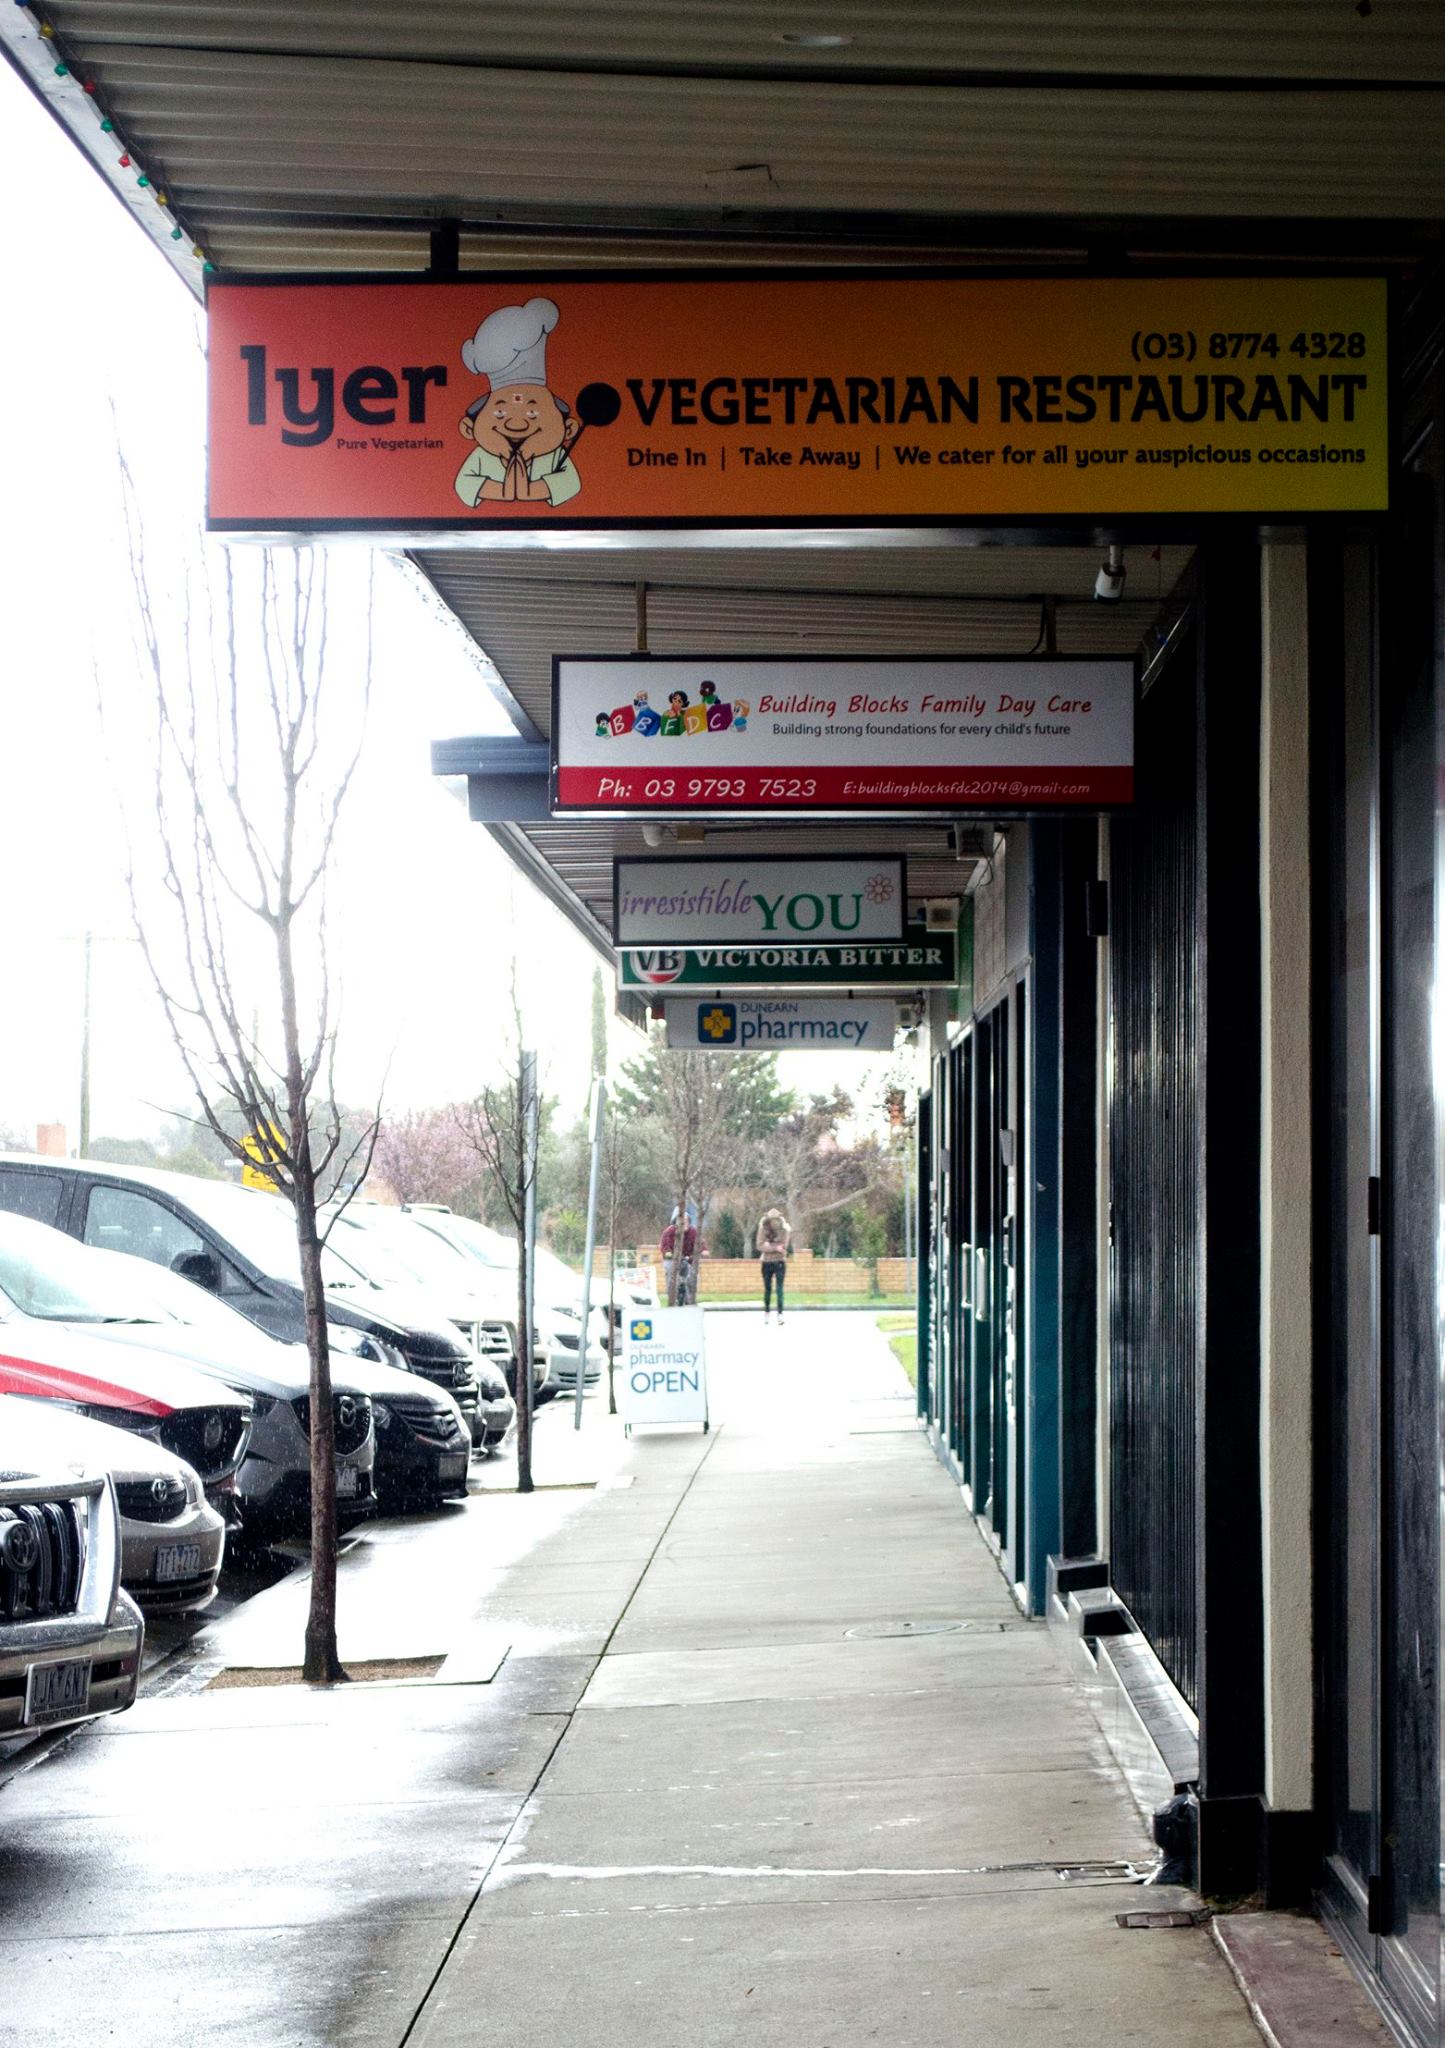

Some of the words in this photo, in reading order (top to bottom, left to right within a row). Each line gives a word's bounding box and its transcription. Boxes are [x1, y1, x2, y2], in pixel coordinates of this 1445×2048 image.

[1132, 331, 1197, 362] (03)
[1209, 333, 1280, 358] 8774
[1290, 332, 1365, 358] 4328
[240, 345, 447, 447] Iyer
[627, 376, 979, 424] VEGETARIAN
[997, 374, 1367, 422] RESTAURANT
[337, 438, 368, 450] Pure
[371, 438, 444, 452] Vegetarian
[627, 447, 676, 466] Dine
[685, 447, 707, 466] In
[740, 447, 793, 466] Take
[800, 447, 861, 469] Away
[895, 447, 932, 465] We
[938, 448, 995, 465] cater
[1002, 445, 1036, 464] for
[1043, 445, 1068, 464] all
[1075, 449, 1129, 469] your
[1136, 445, 1251, 469] auspicious
[1258, 444, 1366, 464] occasions
[759, 694, 836, 717] Building
[848, 695, 909, 713] Blocks
[921, 695, 986, 717] Family
[997, 695, 1036, 717] Day
[1047, 695, 1092, 713] Care
[773, 723, 822, 737] Building
[825, 724, 863, 737] strong
[866, 722, 937, 735] foundations
[939, 722, 957, 735] for
[959, 725, 993, 737] every
[995, 722, 1032, 735] child's
[1034, 722, 1071, 735] future
[597, 777, 632, 798] Ph:
[645, 779, 676, 797] 03
[688, 779, 746, 797] 9793
[759, 779, 817, 797] 7523
[622, 879, 751, 916] irresistible
[752, 894, 863, 931] YOU
[636, 949, 680, 971] VB
[696, 949, 831, 967] VICTORIA
[839, 948, 943, 966] BITTER
[741, 1002, 798, 1013] DUNEARN
[741, 1014, 869, 1046] pharmacy
[630, 1350, 699, 1368] pharmacy
[631, 1371, 699, 1393] OPEN
